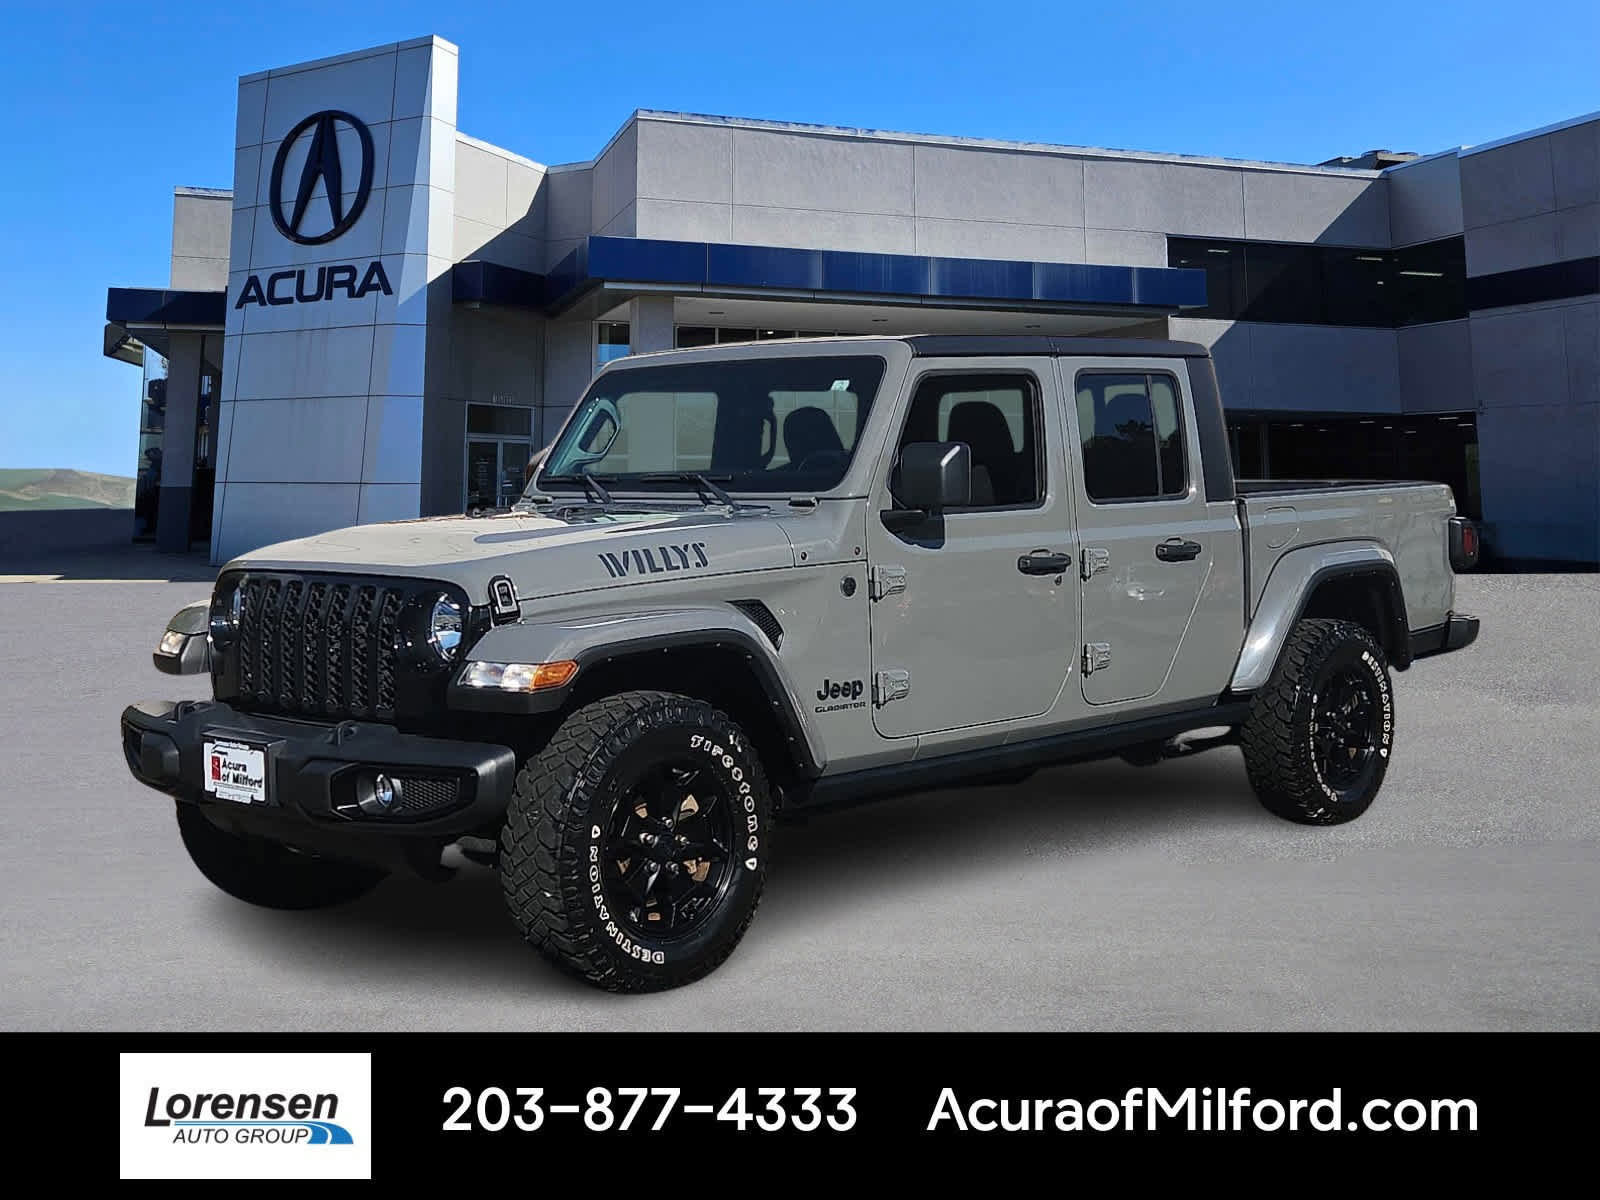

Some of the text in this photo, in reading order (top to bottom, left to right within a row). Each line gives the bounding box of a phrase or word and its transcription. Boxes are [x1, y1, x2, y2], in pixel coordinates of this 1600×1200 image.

[235, 261, 394, 310] ACURA
[598, 542, 709, 578] WILLYS
[816, 679, 864, 701] Jeep
[814, 701, 867, 714] GLADIATOR
[222, 757, 248, 773] Acura
[222, 771, 231, 783] of
[589, 846, 665, 964] DESTINATION
